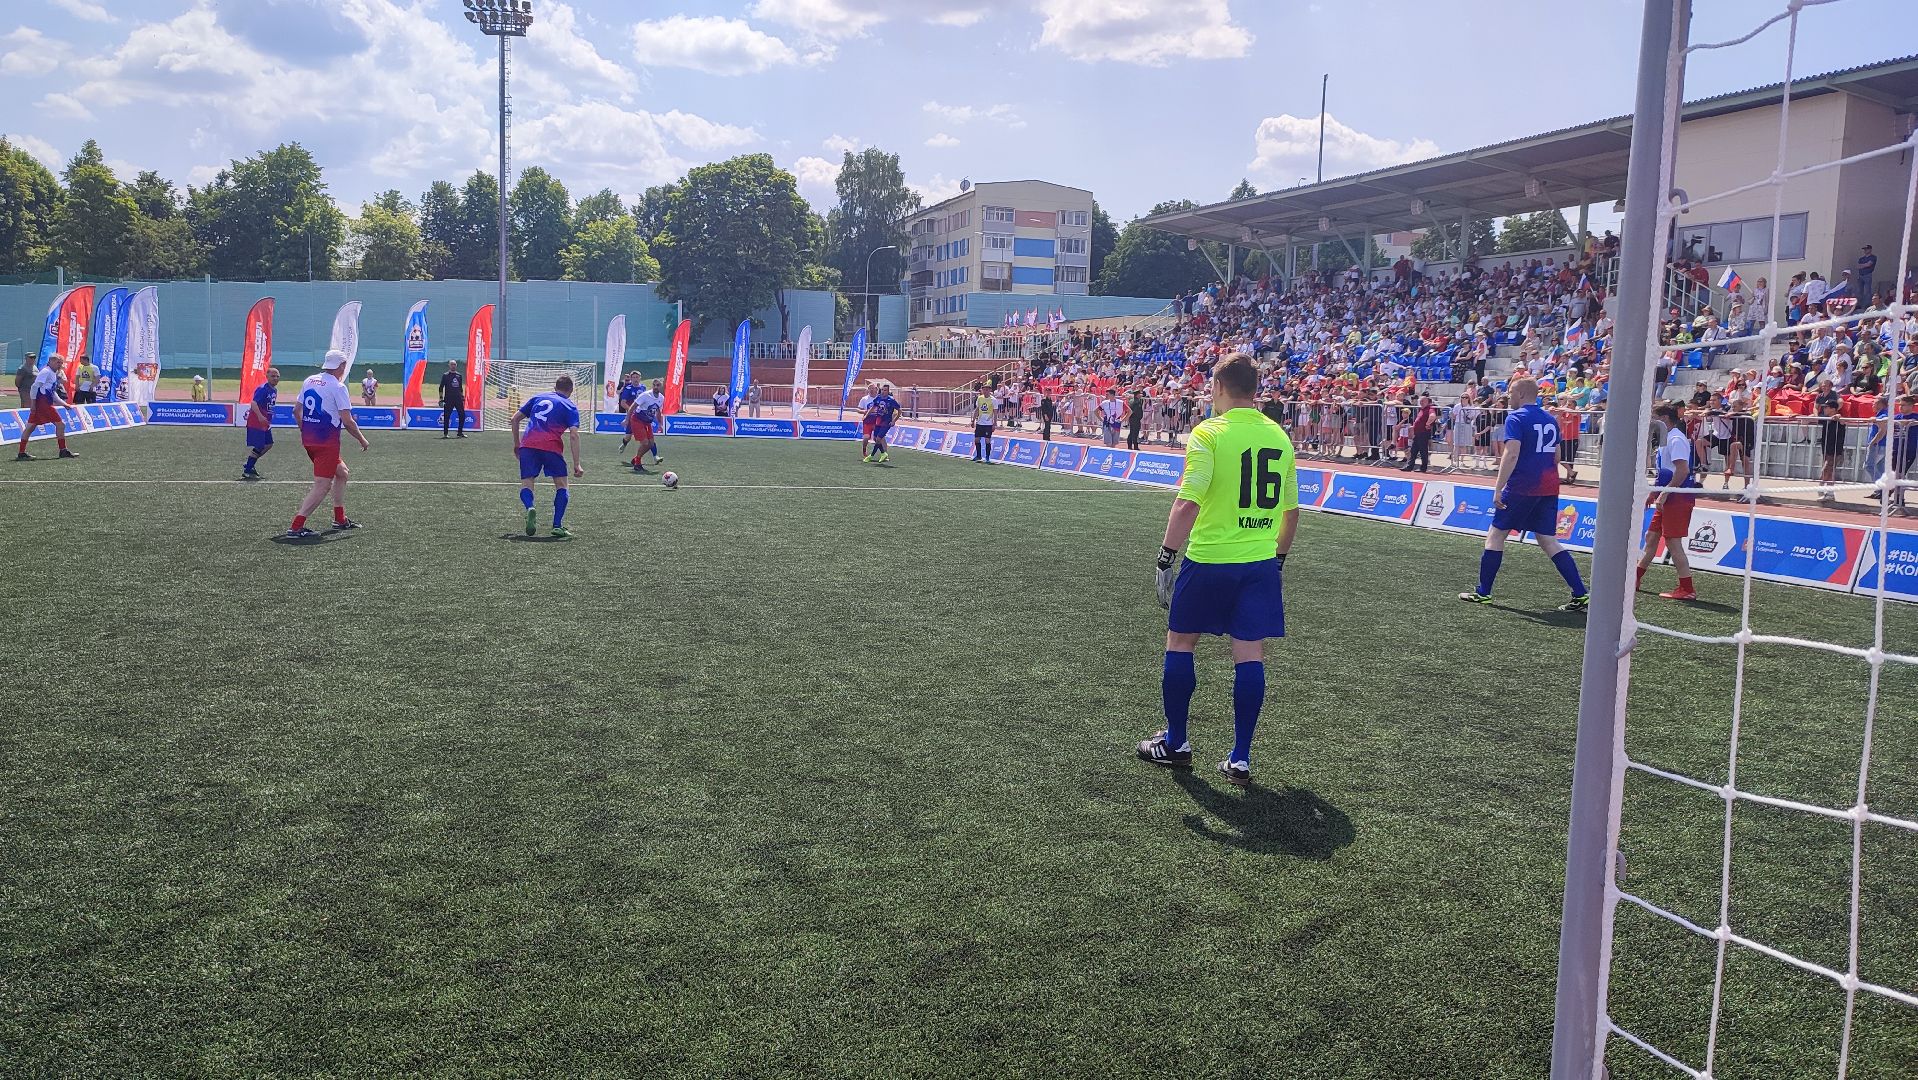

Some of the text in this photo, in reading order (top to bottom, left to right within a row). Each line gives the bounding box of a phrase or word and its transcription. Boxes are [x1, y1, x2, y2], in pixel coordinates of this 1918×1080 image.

[305, 396, 316, 416] 9
[535, 400, 554, 422] 2
[1533, 423, 1557, 453] 12
[1238, 447, 1284, 510] 16
